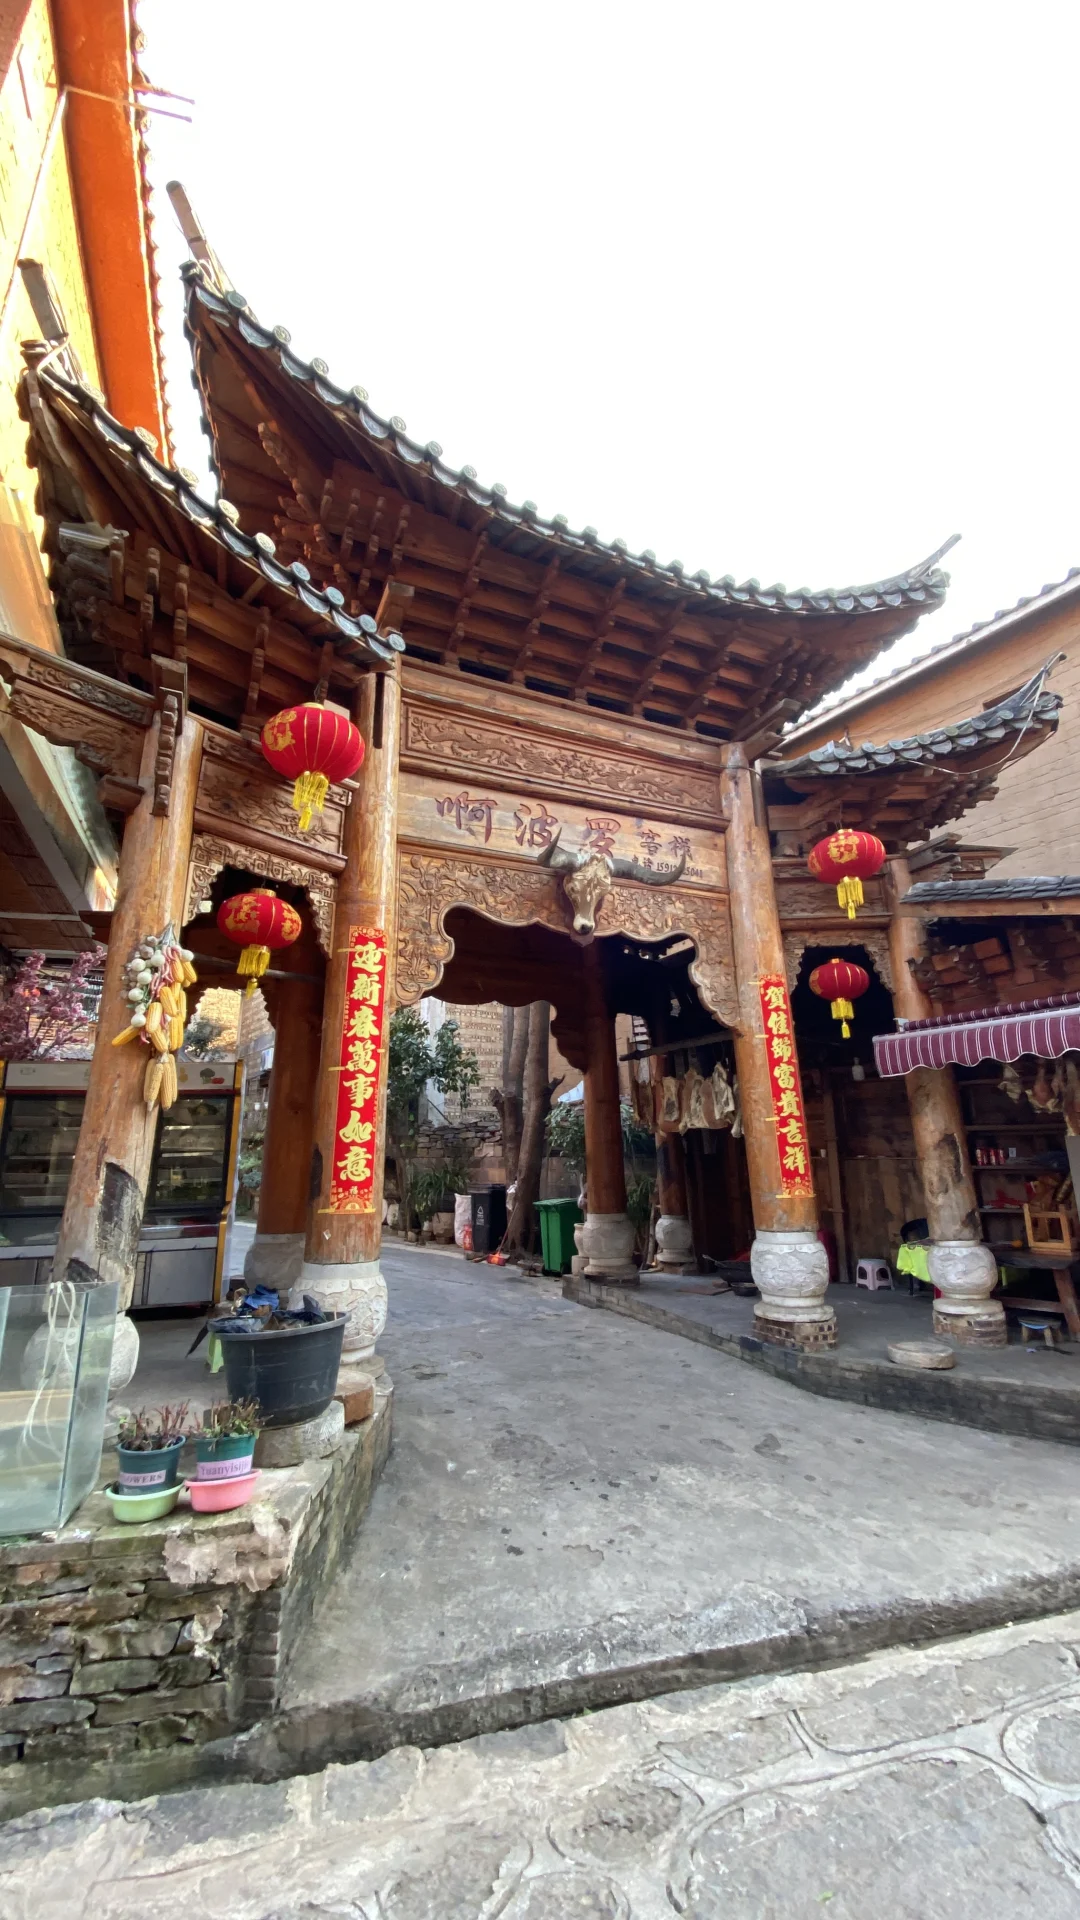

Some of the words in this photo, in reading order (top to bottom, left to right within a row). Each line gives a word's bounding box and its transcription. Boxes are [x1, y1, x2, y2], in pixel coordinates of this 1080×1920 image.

[336, 941, 383, 1182] 迎新春萬事如意
